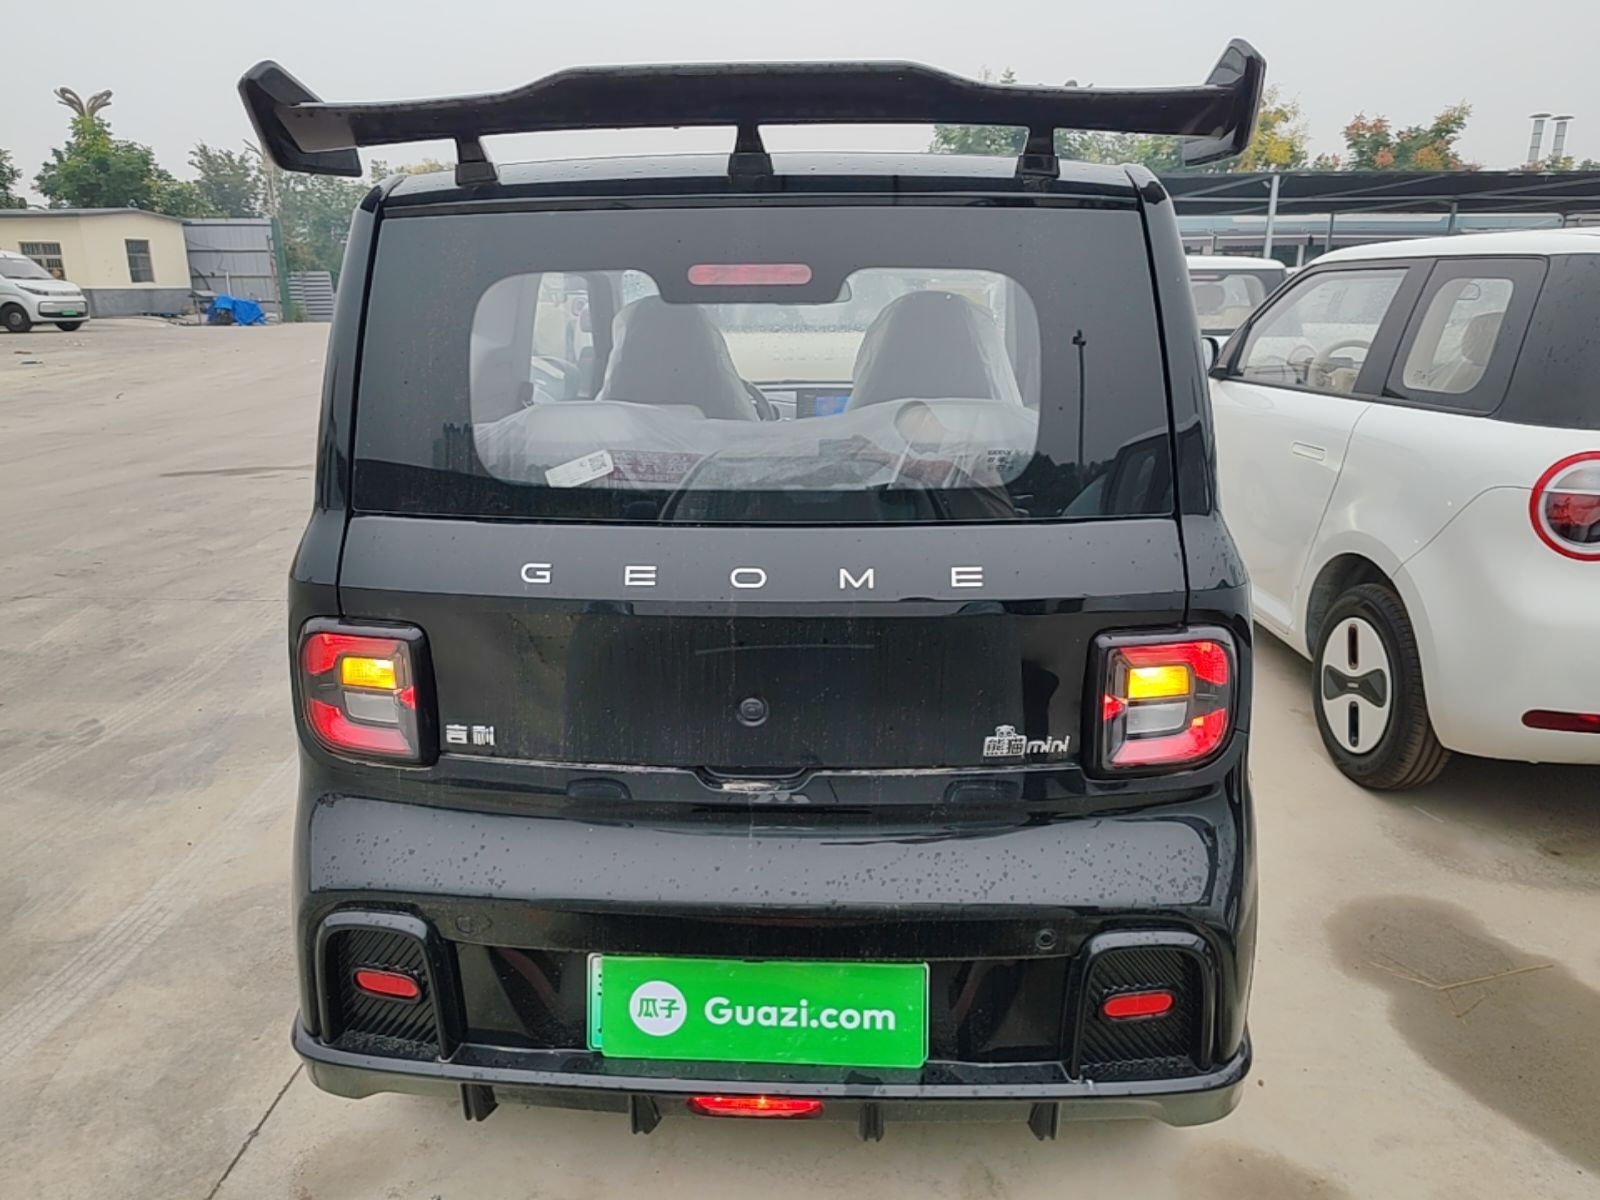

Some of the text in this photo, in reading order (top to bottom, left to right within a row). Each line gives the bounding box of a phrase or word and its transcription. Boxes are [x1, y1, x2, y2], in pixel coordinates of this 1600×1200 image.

[520, 562, 985, 589] GEOME
[637, 996, 895, 1030] 瓜子 Guazi.com
